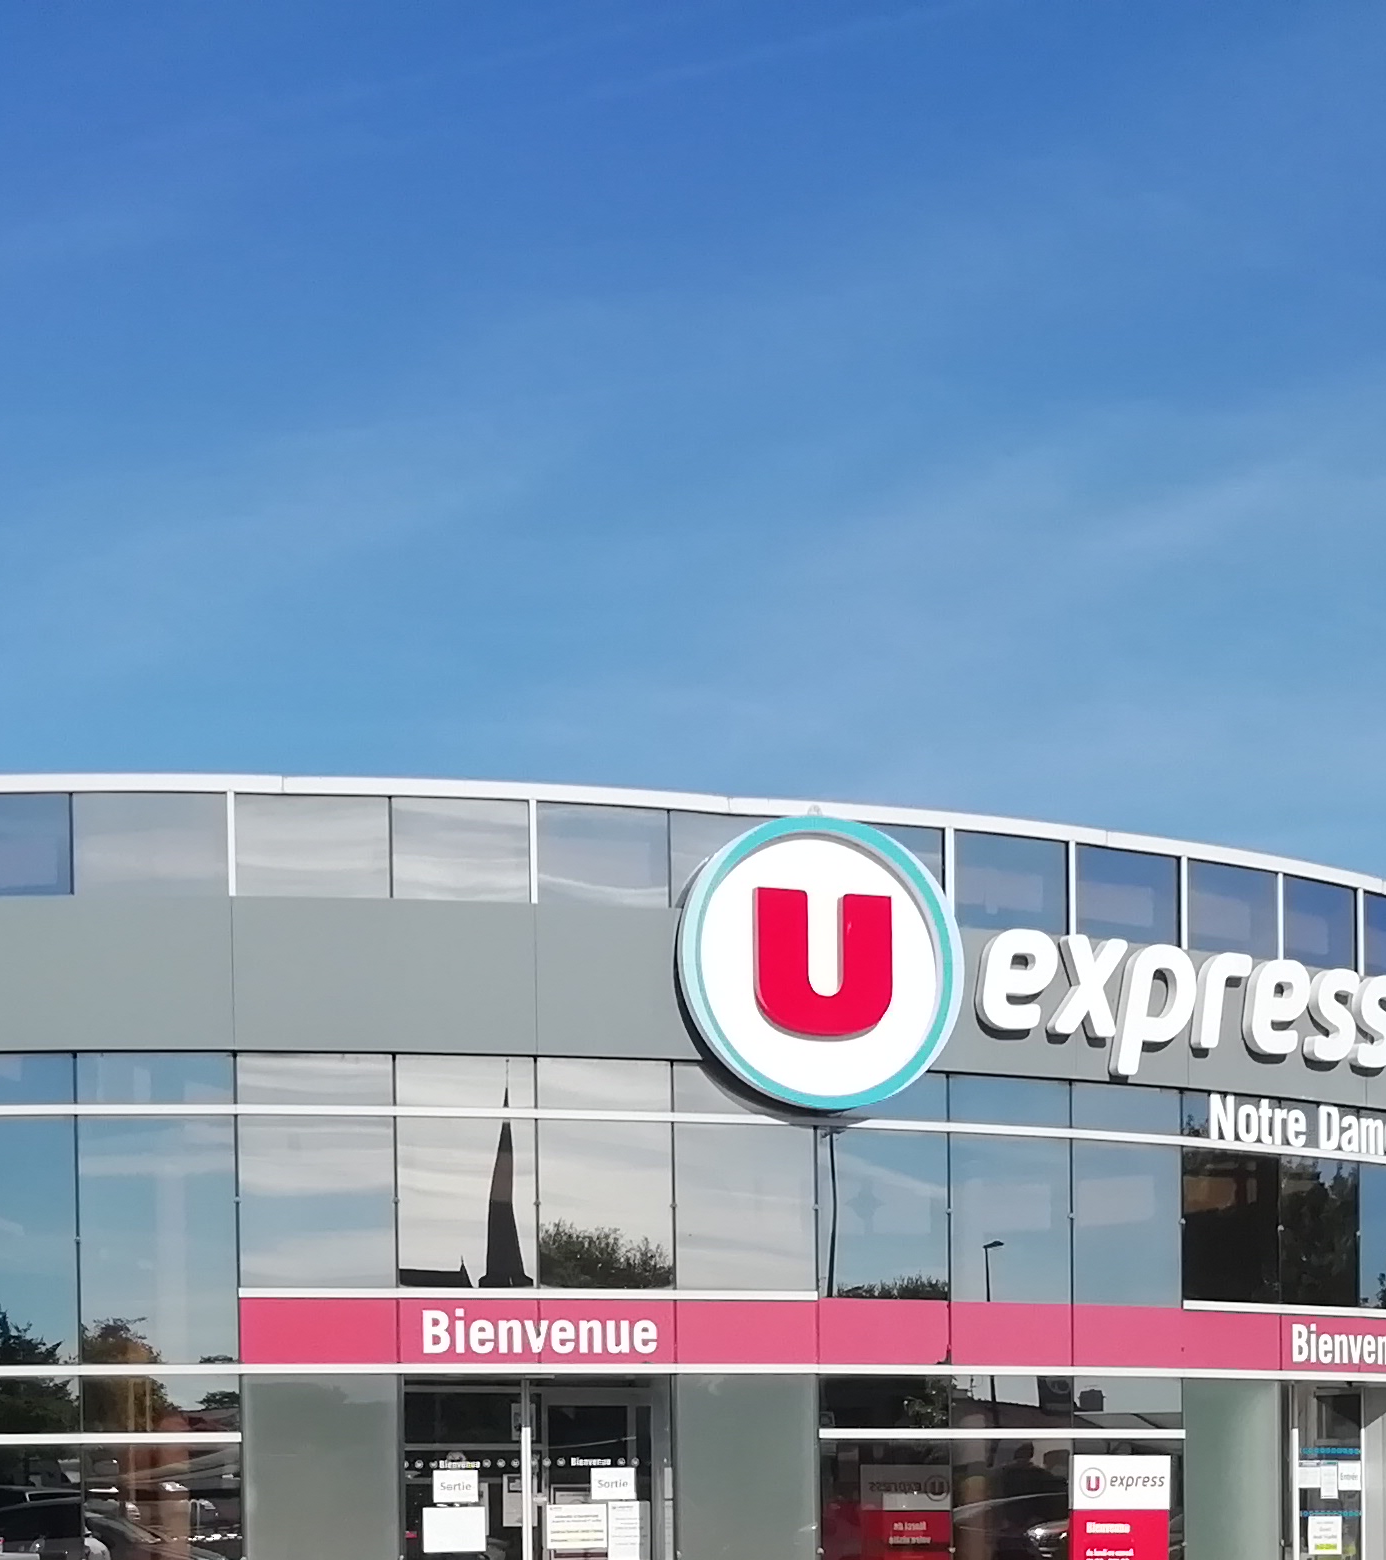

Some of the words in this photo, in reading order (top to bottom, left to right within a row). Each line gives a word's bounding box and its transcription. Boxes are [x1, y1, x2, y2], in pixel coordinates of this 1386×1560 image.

[752, 886, 894, 1037] U
[1208, 1093, 1307, 1148] Notre
[421, 1308, 658, 1355] Bienvenue
[439, 1481, 473, 1492] Sortie
[596, 1478, 629, 1489] Sortie
[1109, 1475, 1166, 1491] express
